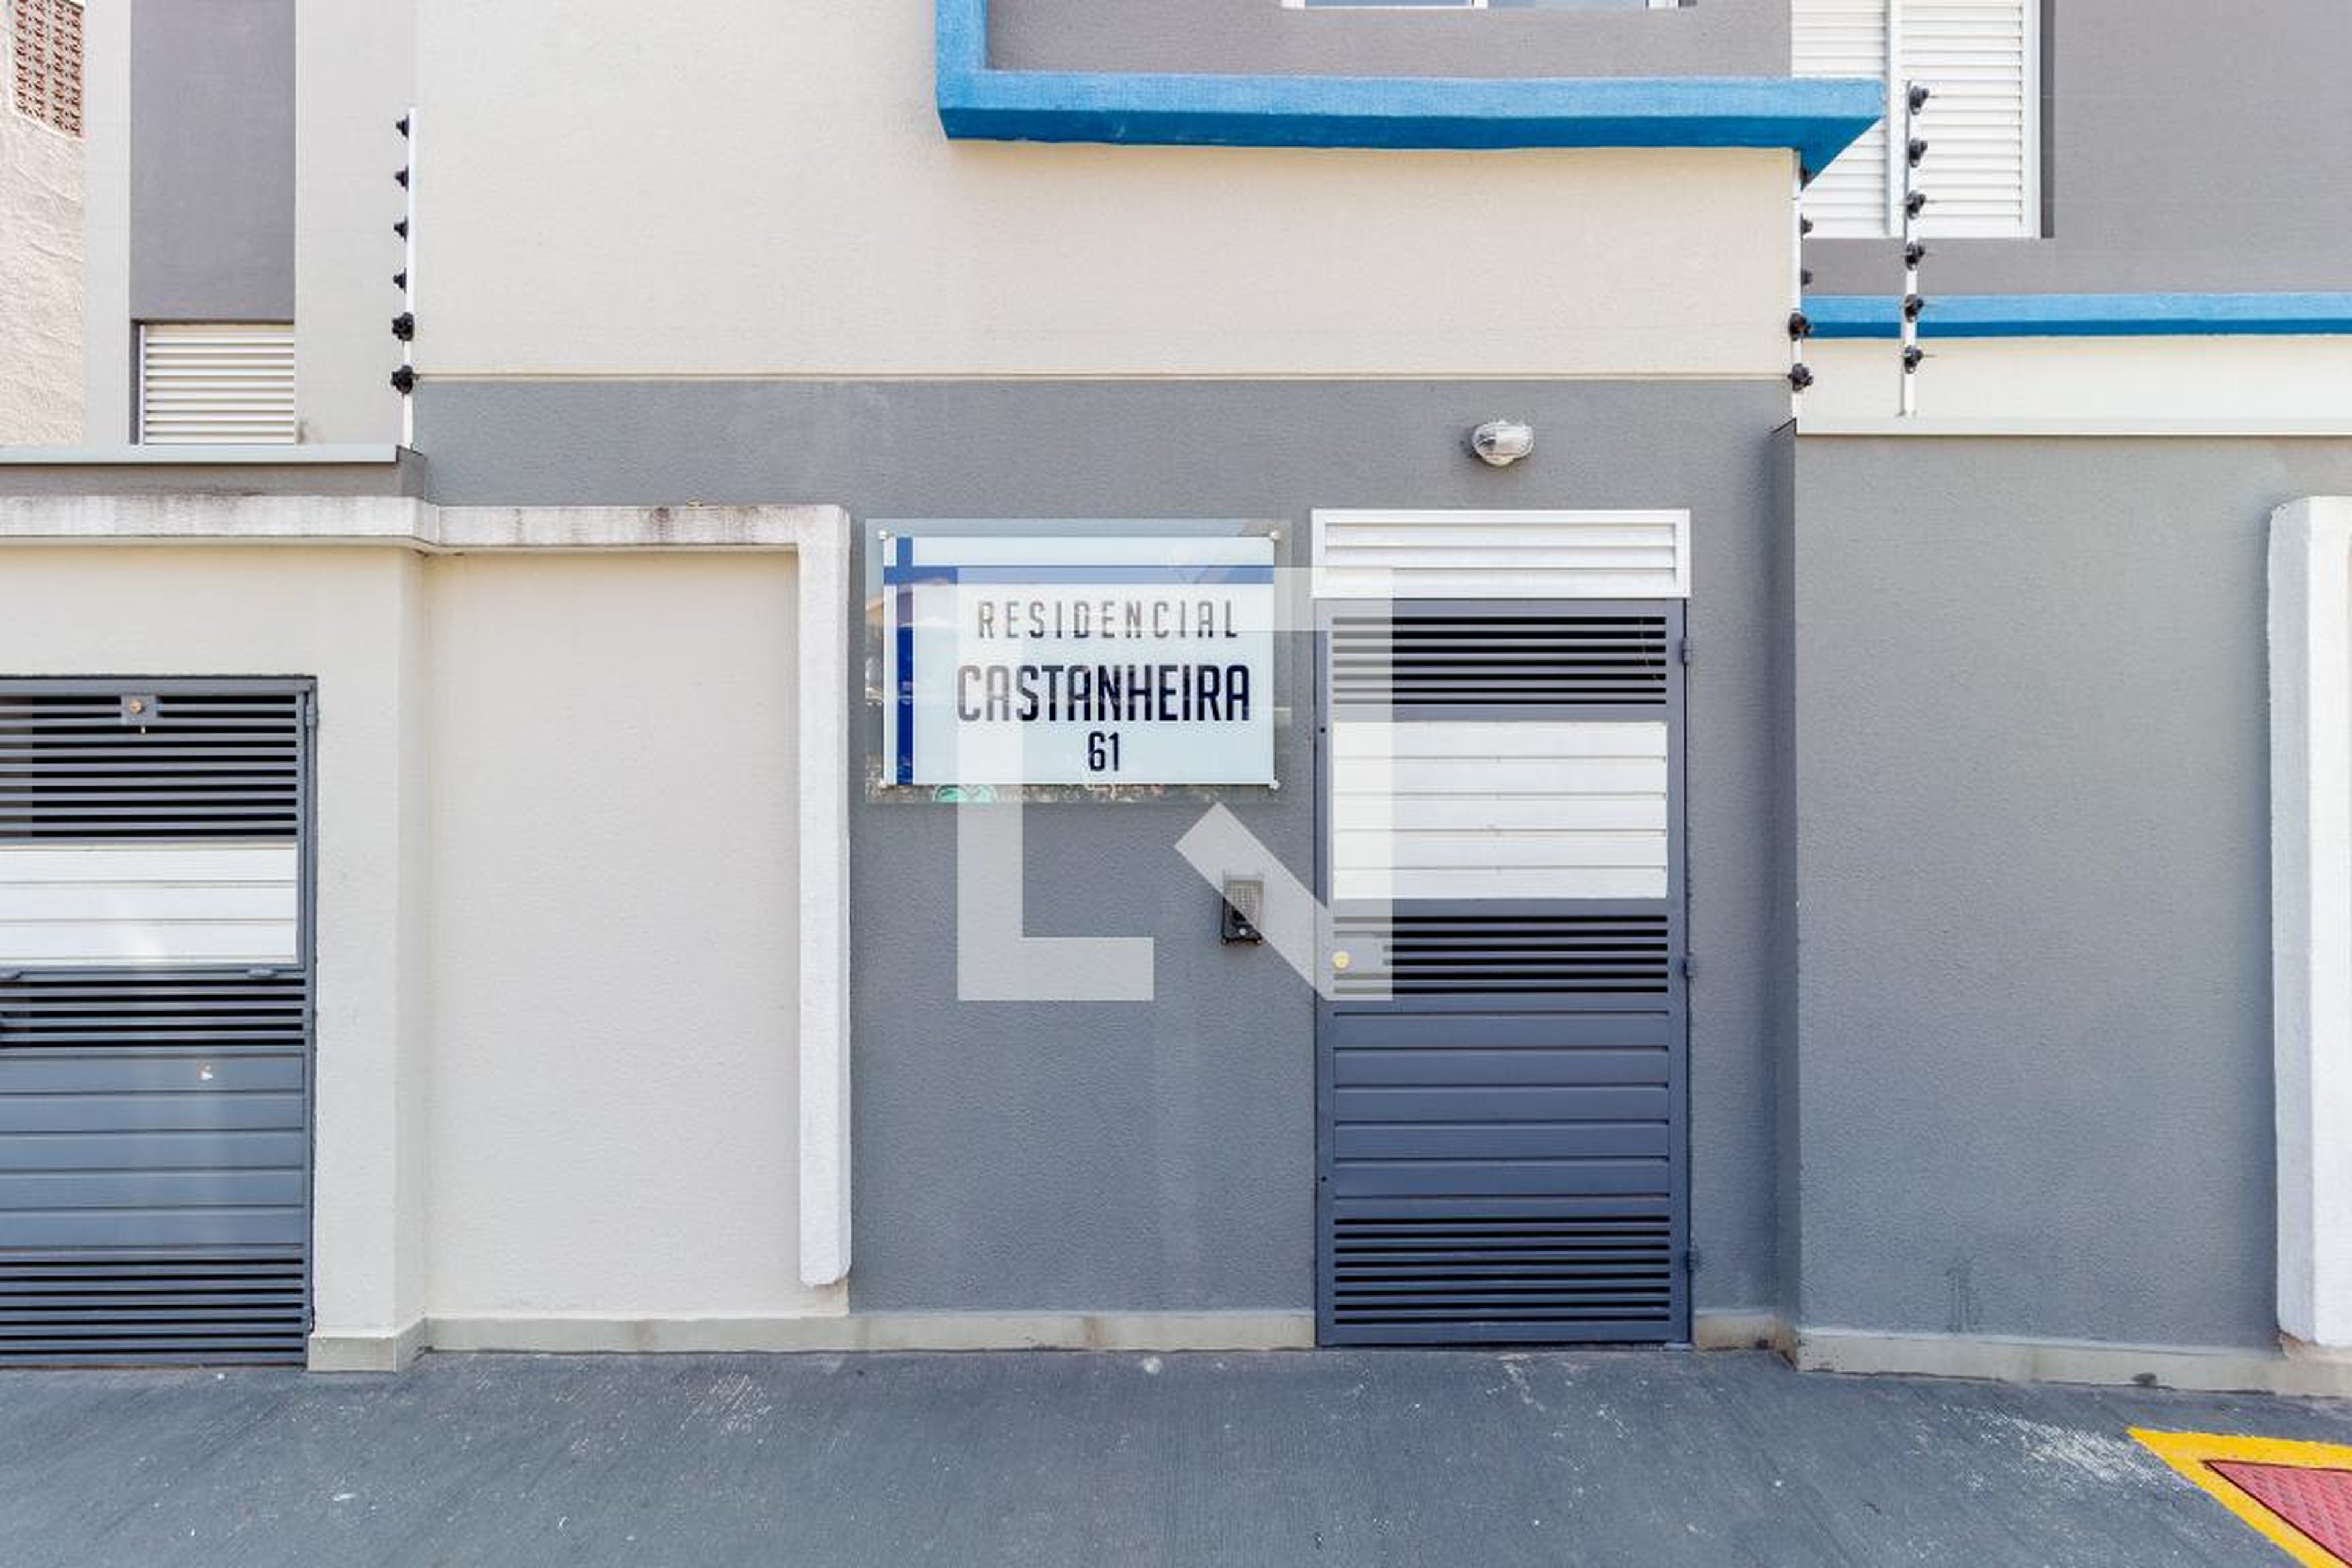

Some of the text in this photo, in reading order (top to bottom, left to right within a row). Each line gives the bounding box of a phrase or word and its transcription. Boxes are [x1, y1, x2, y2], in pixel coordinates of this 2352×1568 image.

[979, 600, 1238, 639] RESIDENCIAL
[957, 664, 1250, 722] CASTANHEIRA
[1088, 731, 1120, 772] 61
